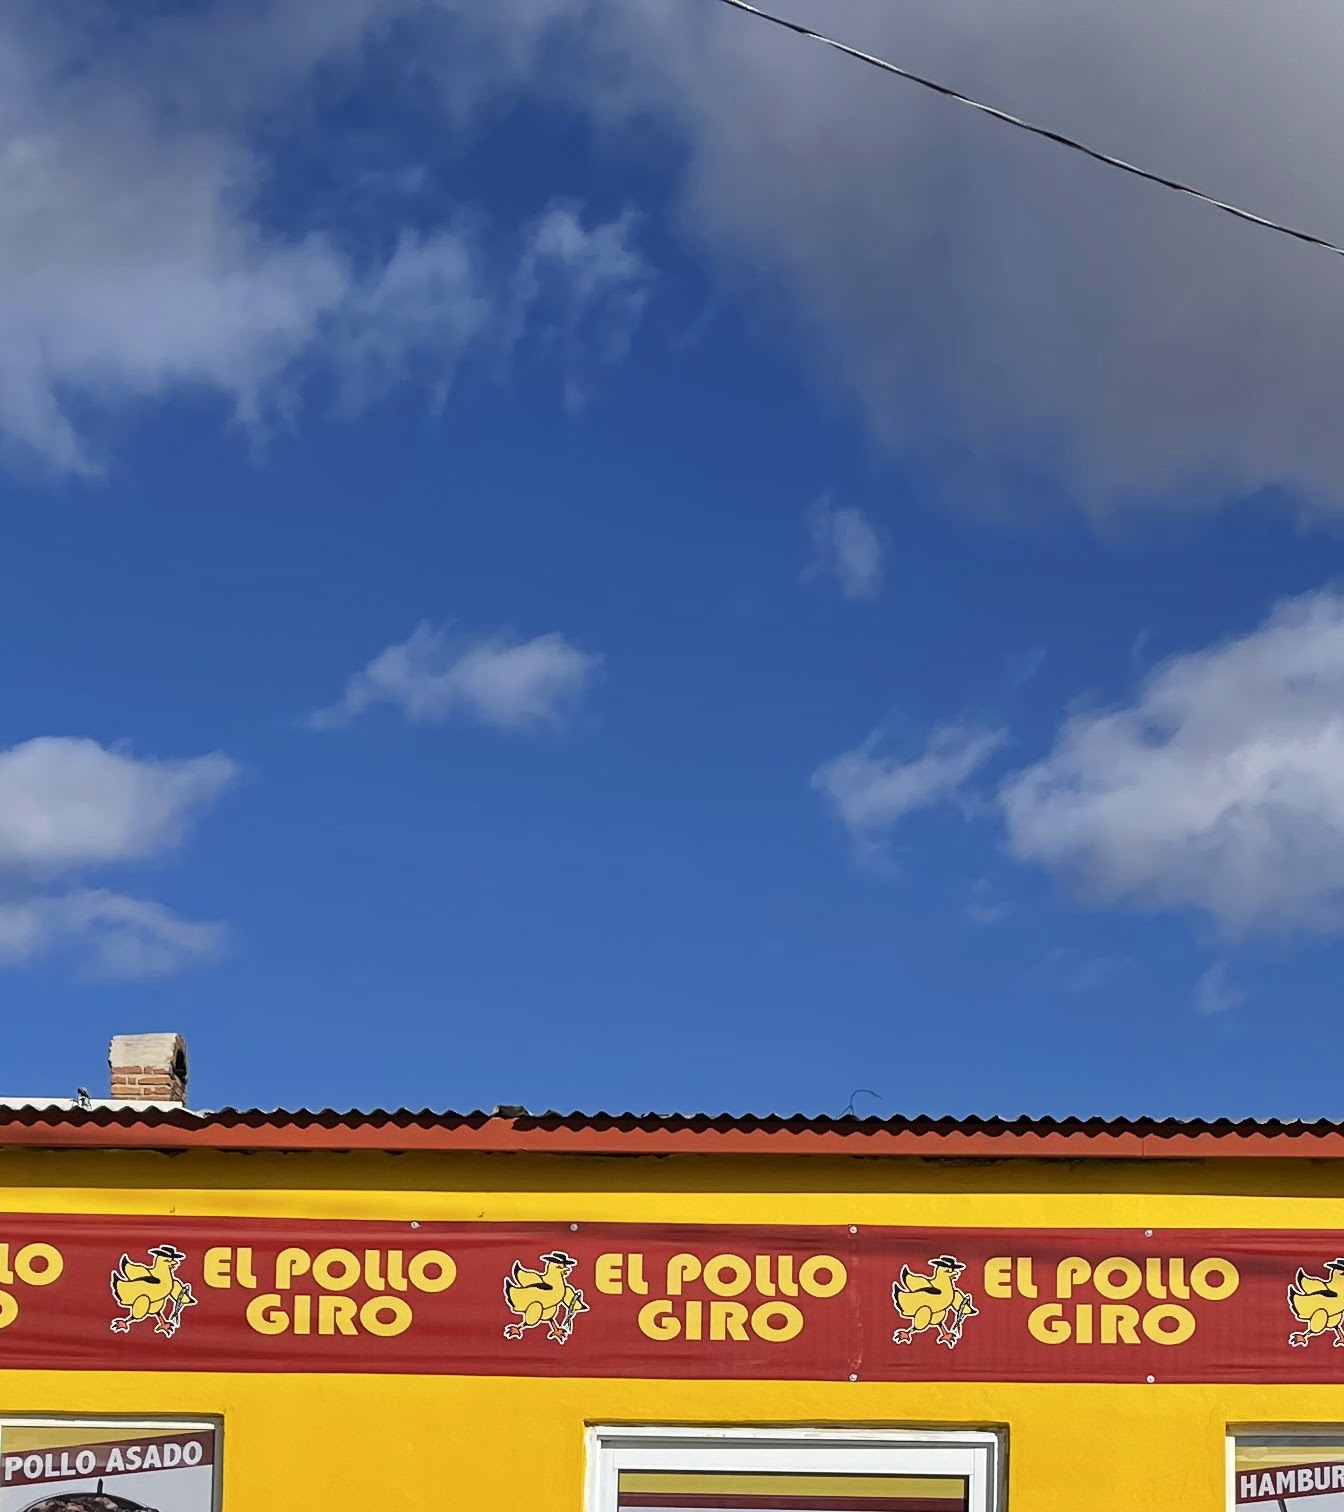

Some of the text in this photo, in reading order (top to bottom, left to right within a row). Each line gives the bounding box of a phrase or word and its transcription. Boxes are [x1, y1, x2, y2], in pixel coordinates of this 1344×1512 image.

[204, 1248, 456, 1292] EL POLLO
[596, 1254, 847, 1297] EL POLLO
[985, 1257, 1239, 1300] EL POLLO
[247, 1294, 412, 1336] GIRO
[638, 1300, 803, 1342] GIRO
[1028, 1304, 1195, 1345] GIRO
[5, 1441, 202, 1480] POLLO ASADO
